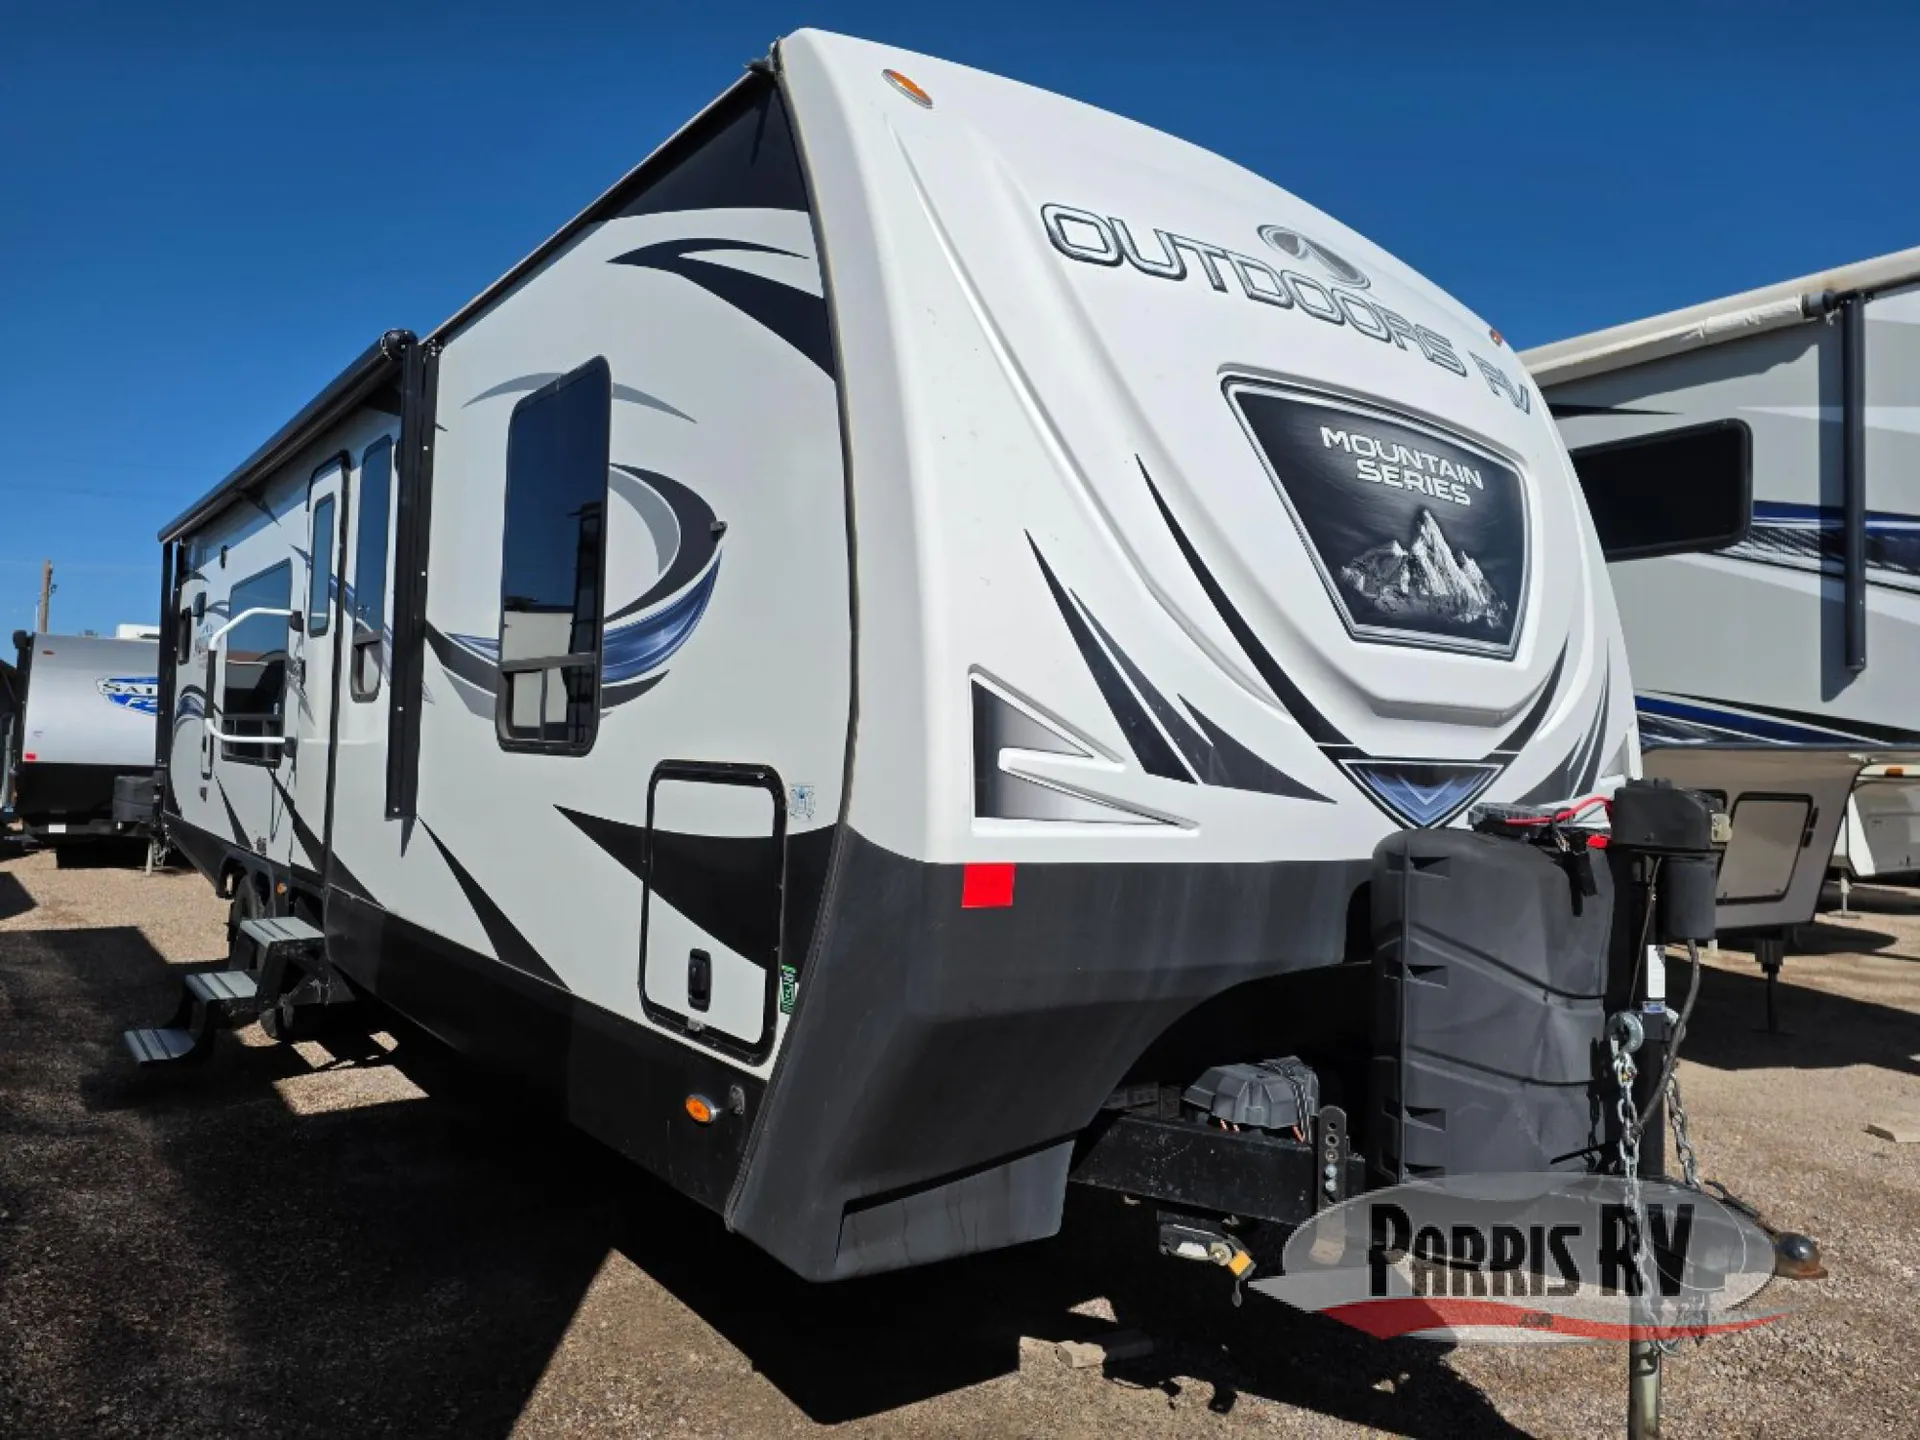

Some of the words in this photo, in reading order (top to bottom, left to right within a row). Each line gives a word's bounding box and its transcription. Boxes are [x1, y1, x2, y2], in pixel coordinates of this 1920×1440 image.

[1041, 203, 1467, 377] OUTDOORS
[1467, 349, 1531, 415] RV
[1320, 426, 1484, 491] MOUNTAIN
[1356, 458, 1471, 506] SERIES
